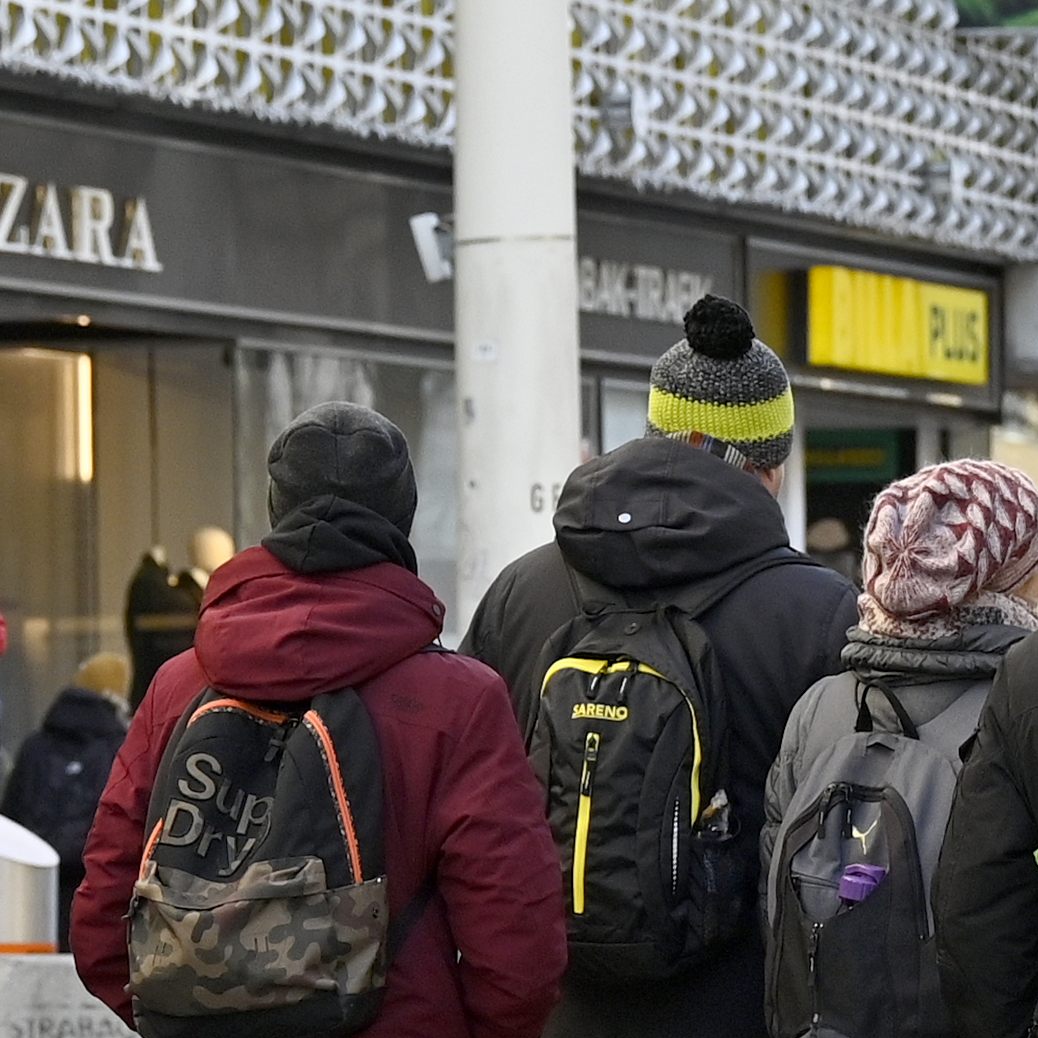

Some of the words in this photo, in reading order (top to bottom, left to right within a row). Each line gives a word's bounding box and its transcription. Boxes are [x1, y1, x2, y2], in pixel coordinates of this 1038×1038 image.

[0, 172, 163, 272] ZARA
[929, 304, 979, 364] PLUS
[160, 798, 256, 876] Dry
